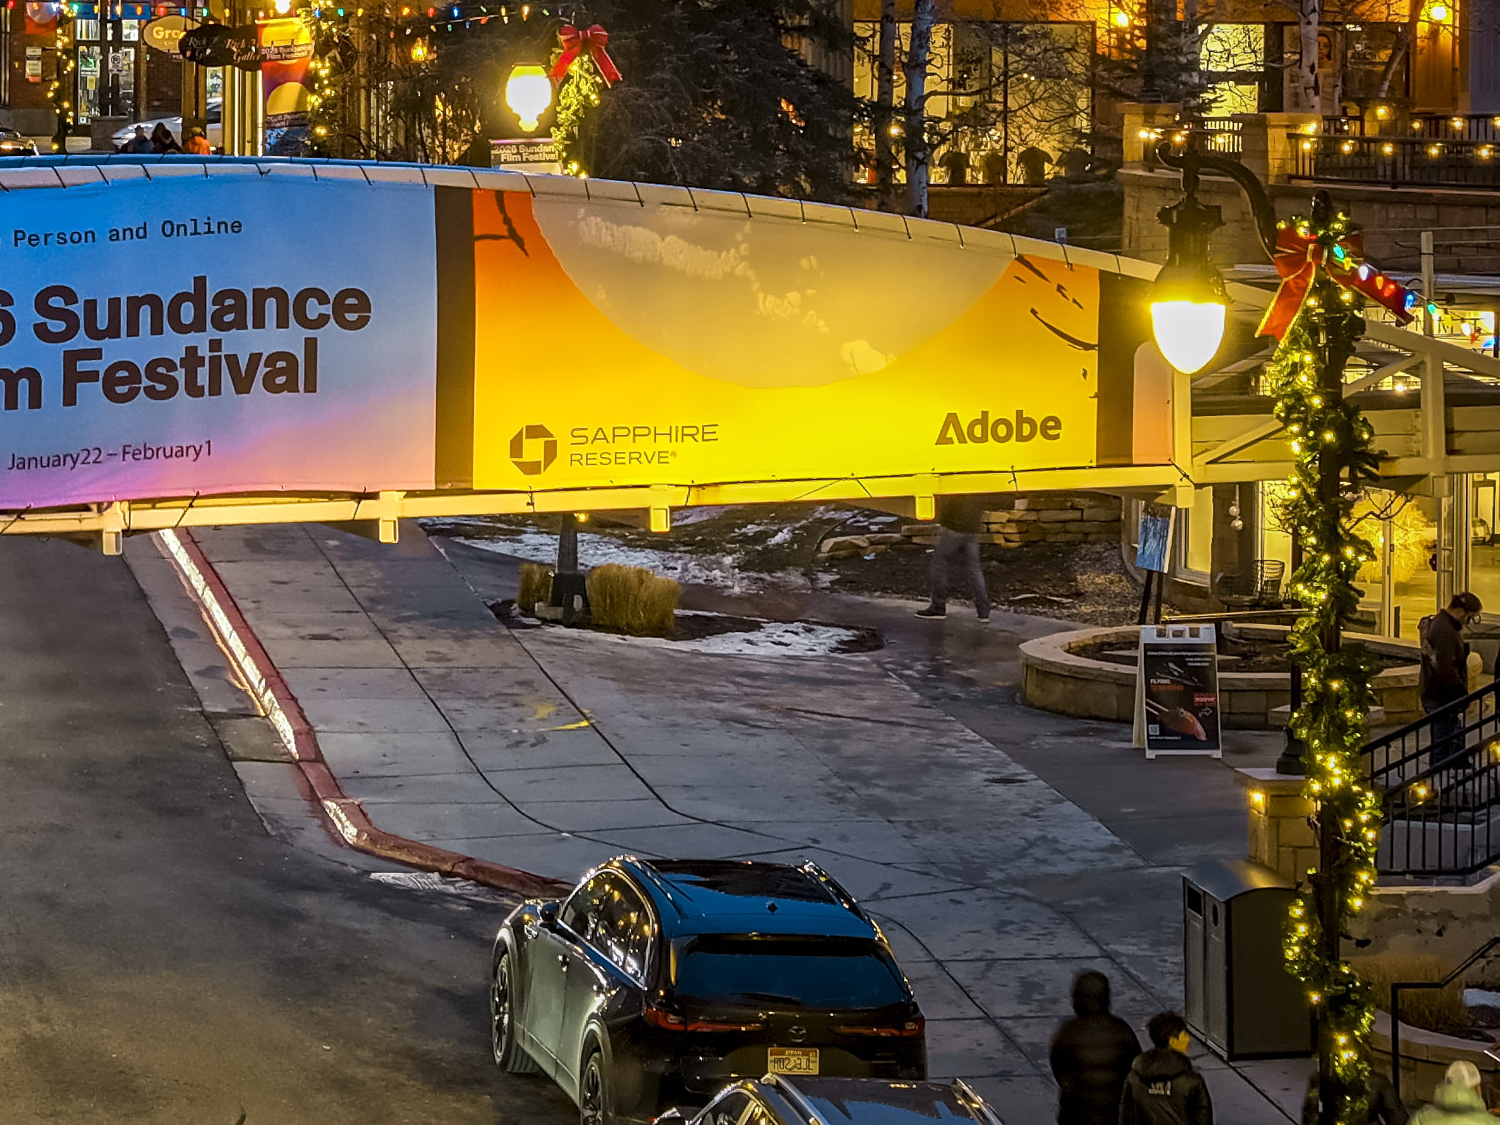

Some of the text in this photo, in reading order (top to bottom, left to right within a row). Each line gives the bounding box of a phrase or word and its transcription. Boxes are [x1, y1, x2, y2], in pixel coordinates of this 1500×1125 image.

[501, 153, 559, 162] Film Festival
[14, 227, 96, 249] Person
[108, 221, 147, 242] and
[161, 217, 243, 239] Online
[33, 275, 372, 344] Sundance
[62, 337, 318, 407] Festival
[569, 424, 720, 446] SAPPHIRE
[935, 409, 1062, 446] Adobe
